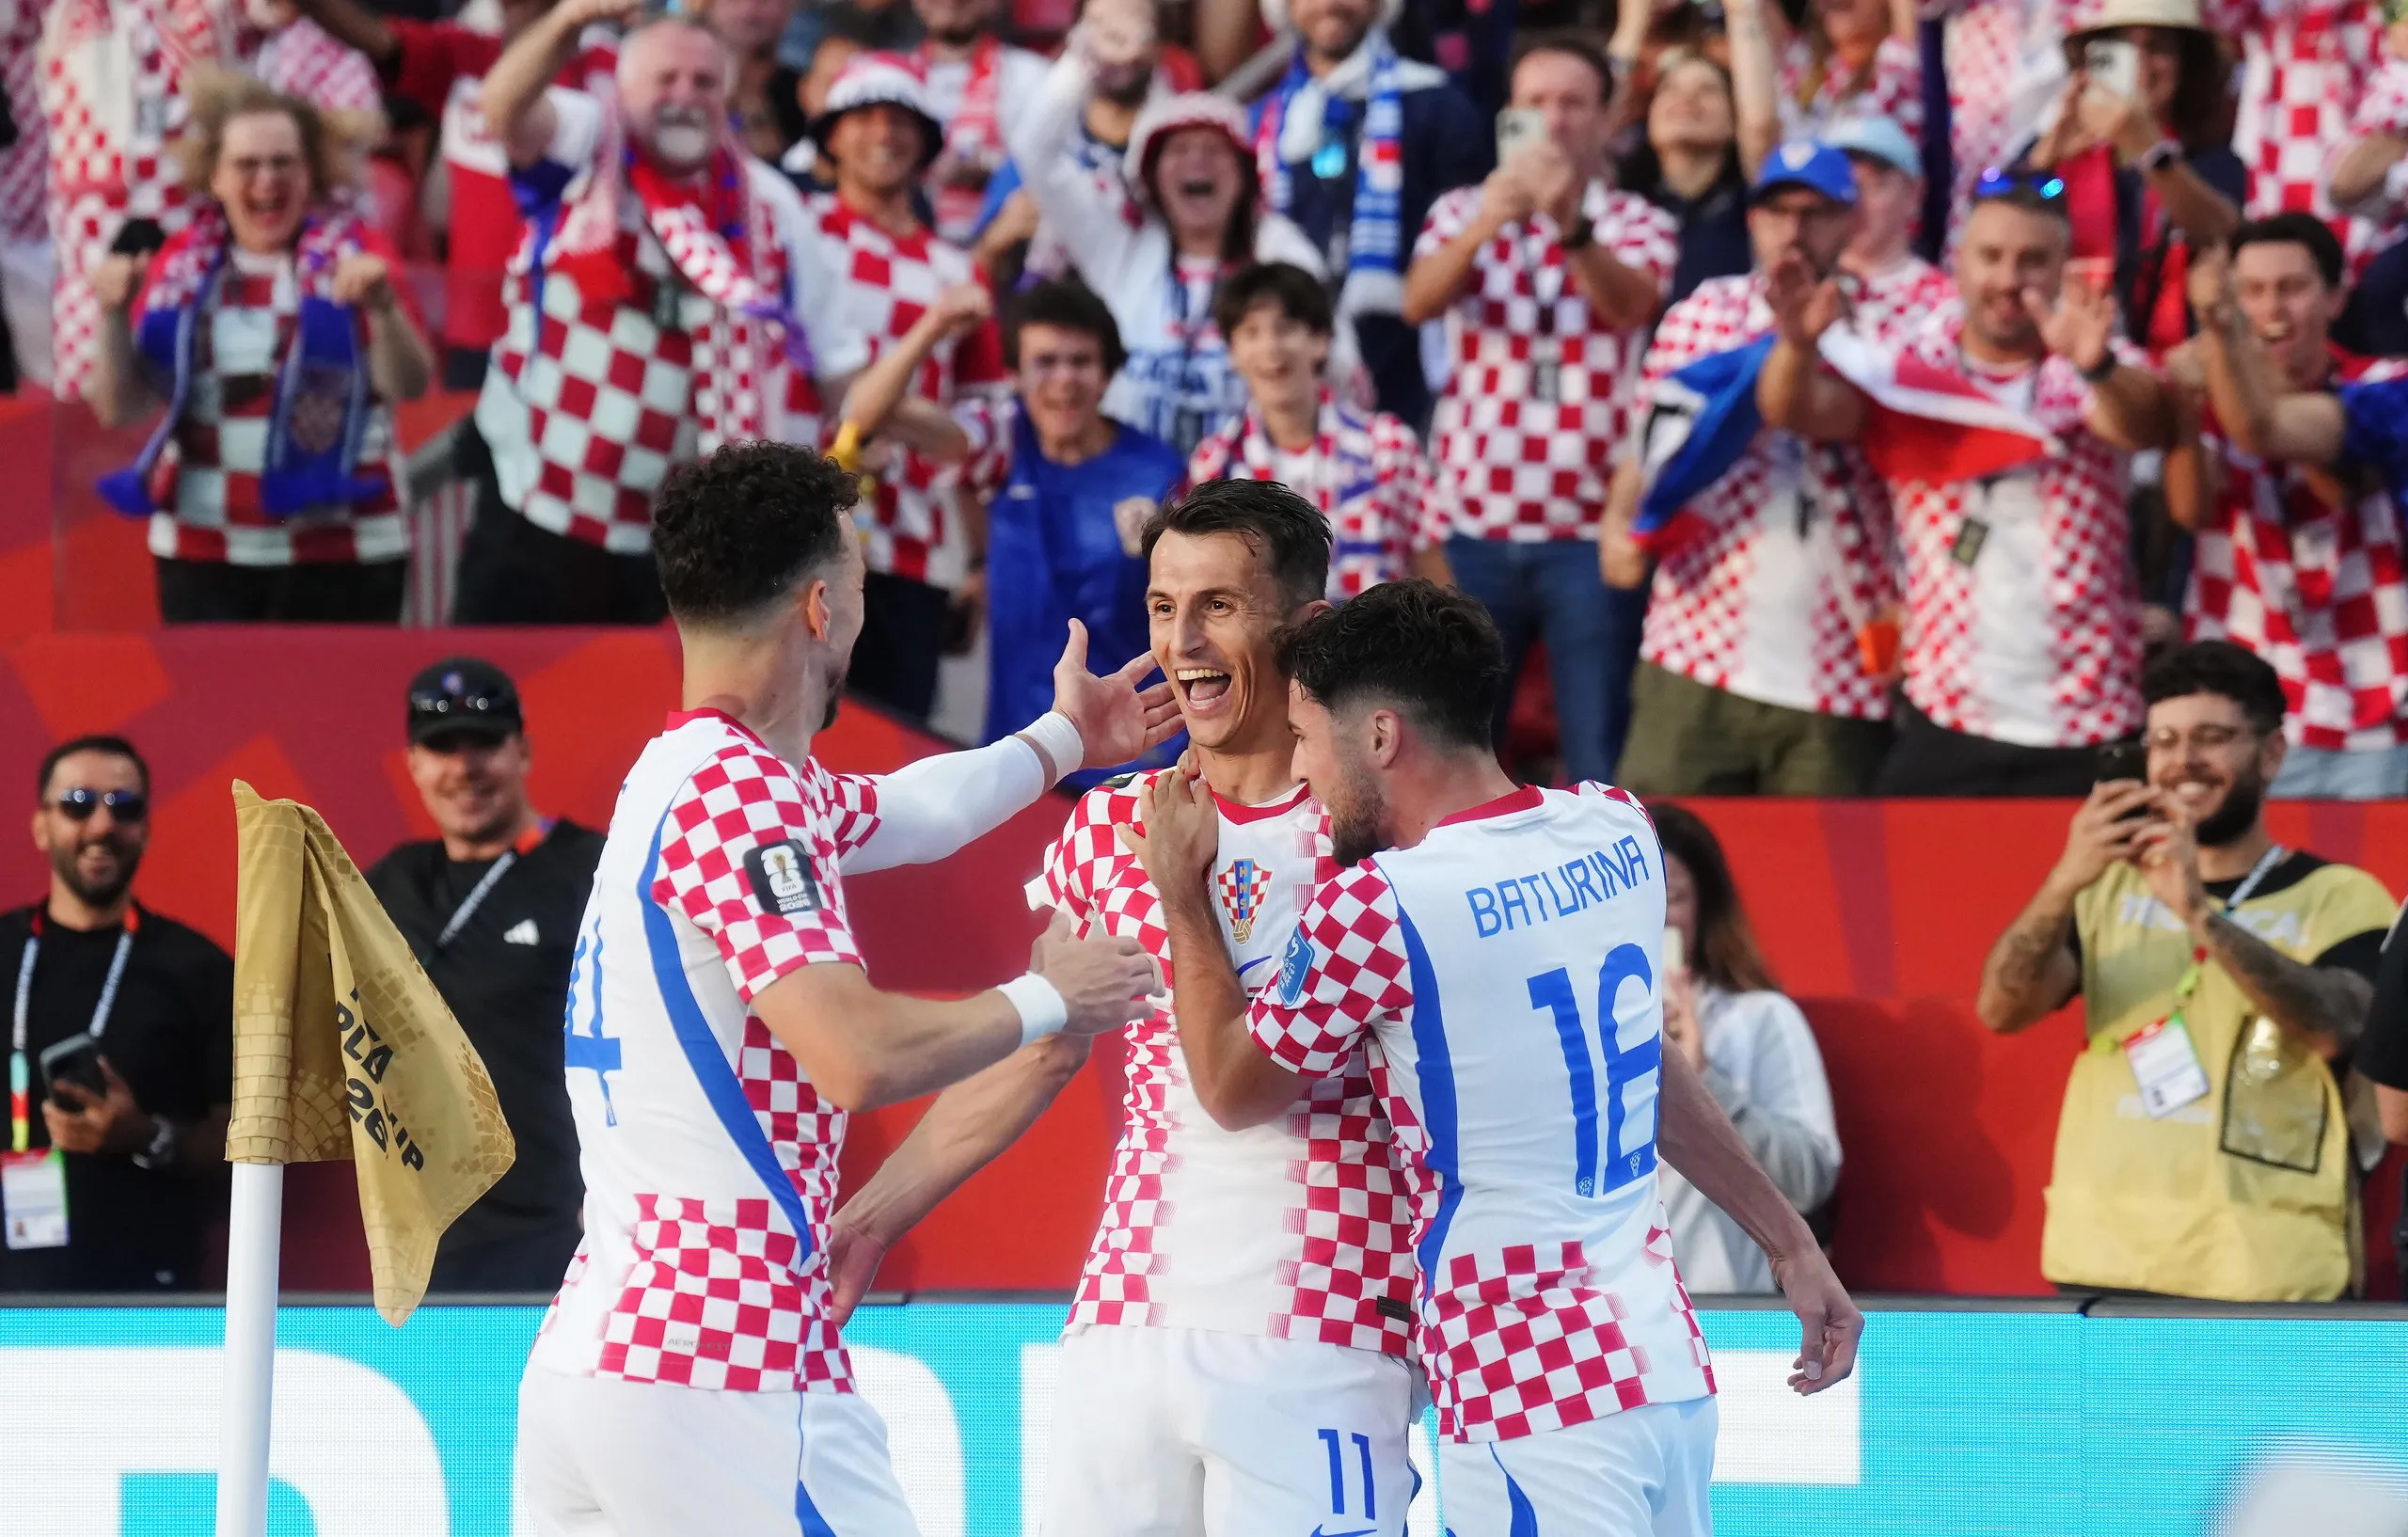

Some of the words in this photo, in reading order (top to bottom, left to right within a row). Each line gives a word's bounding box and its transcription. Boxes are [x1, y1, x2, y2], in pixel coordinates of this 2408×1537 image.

[1239, 865, 1249, 911] HNS
[1465, 834, 1649, 938] BATURINA
[1527, 943, 1662, 1198] 16
[1318, 1428, 1376, 1521] 11
